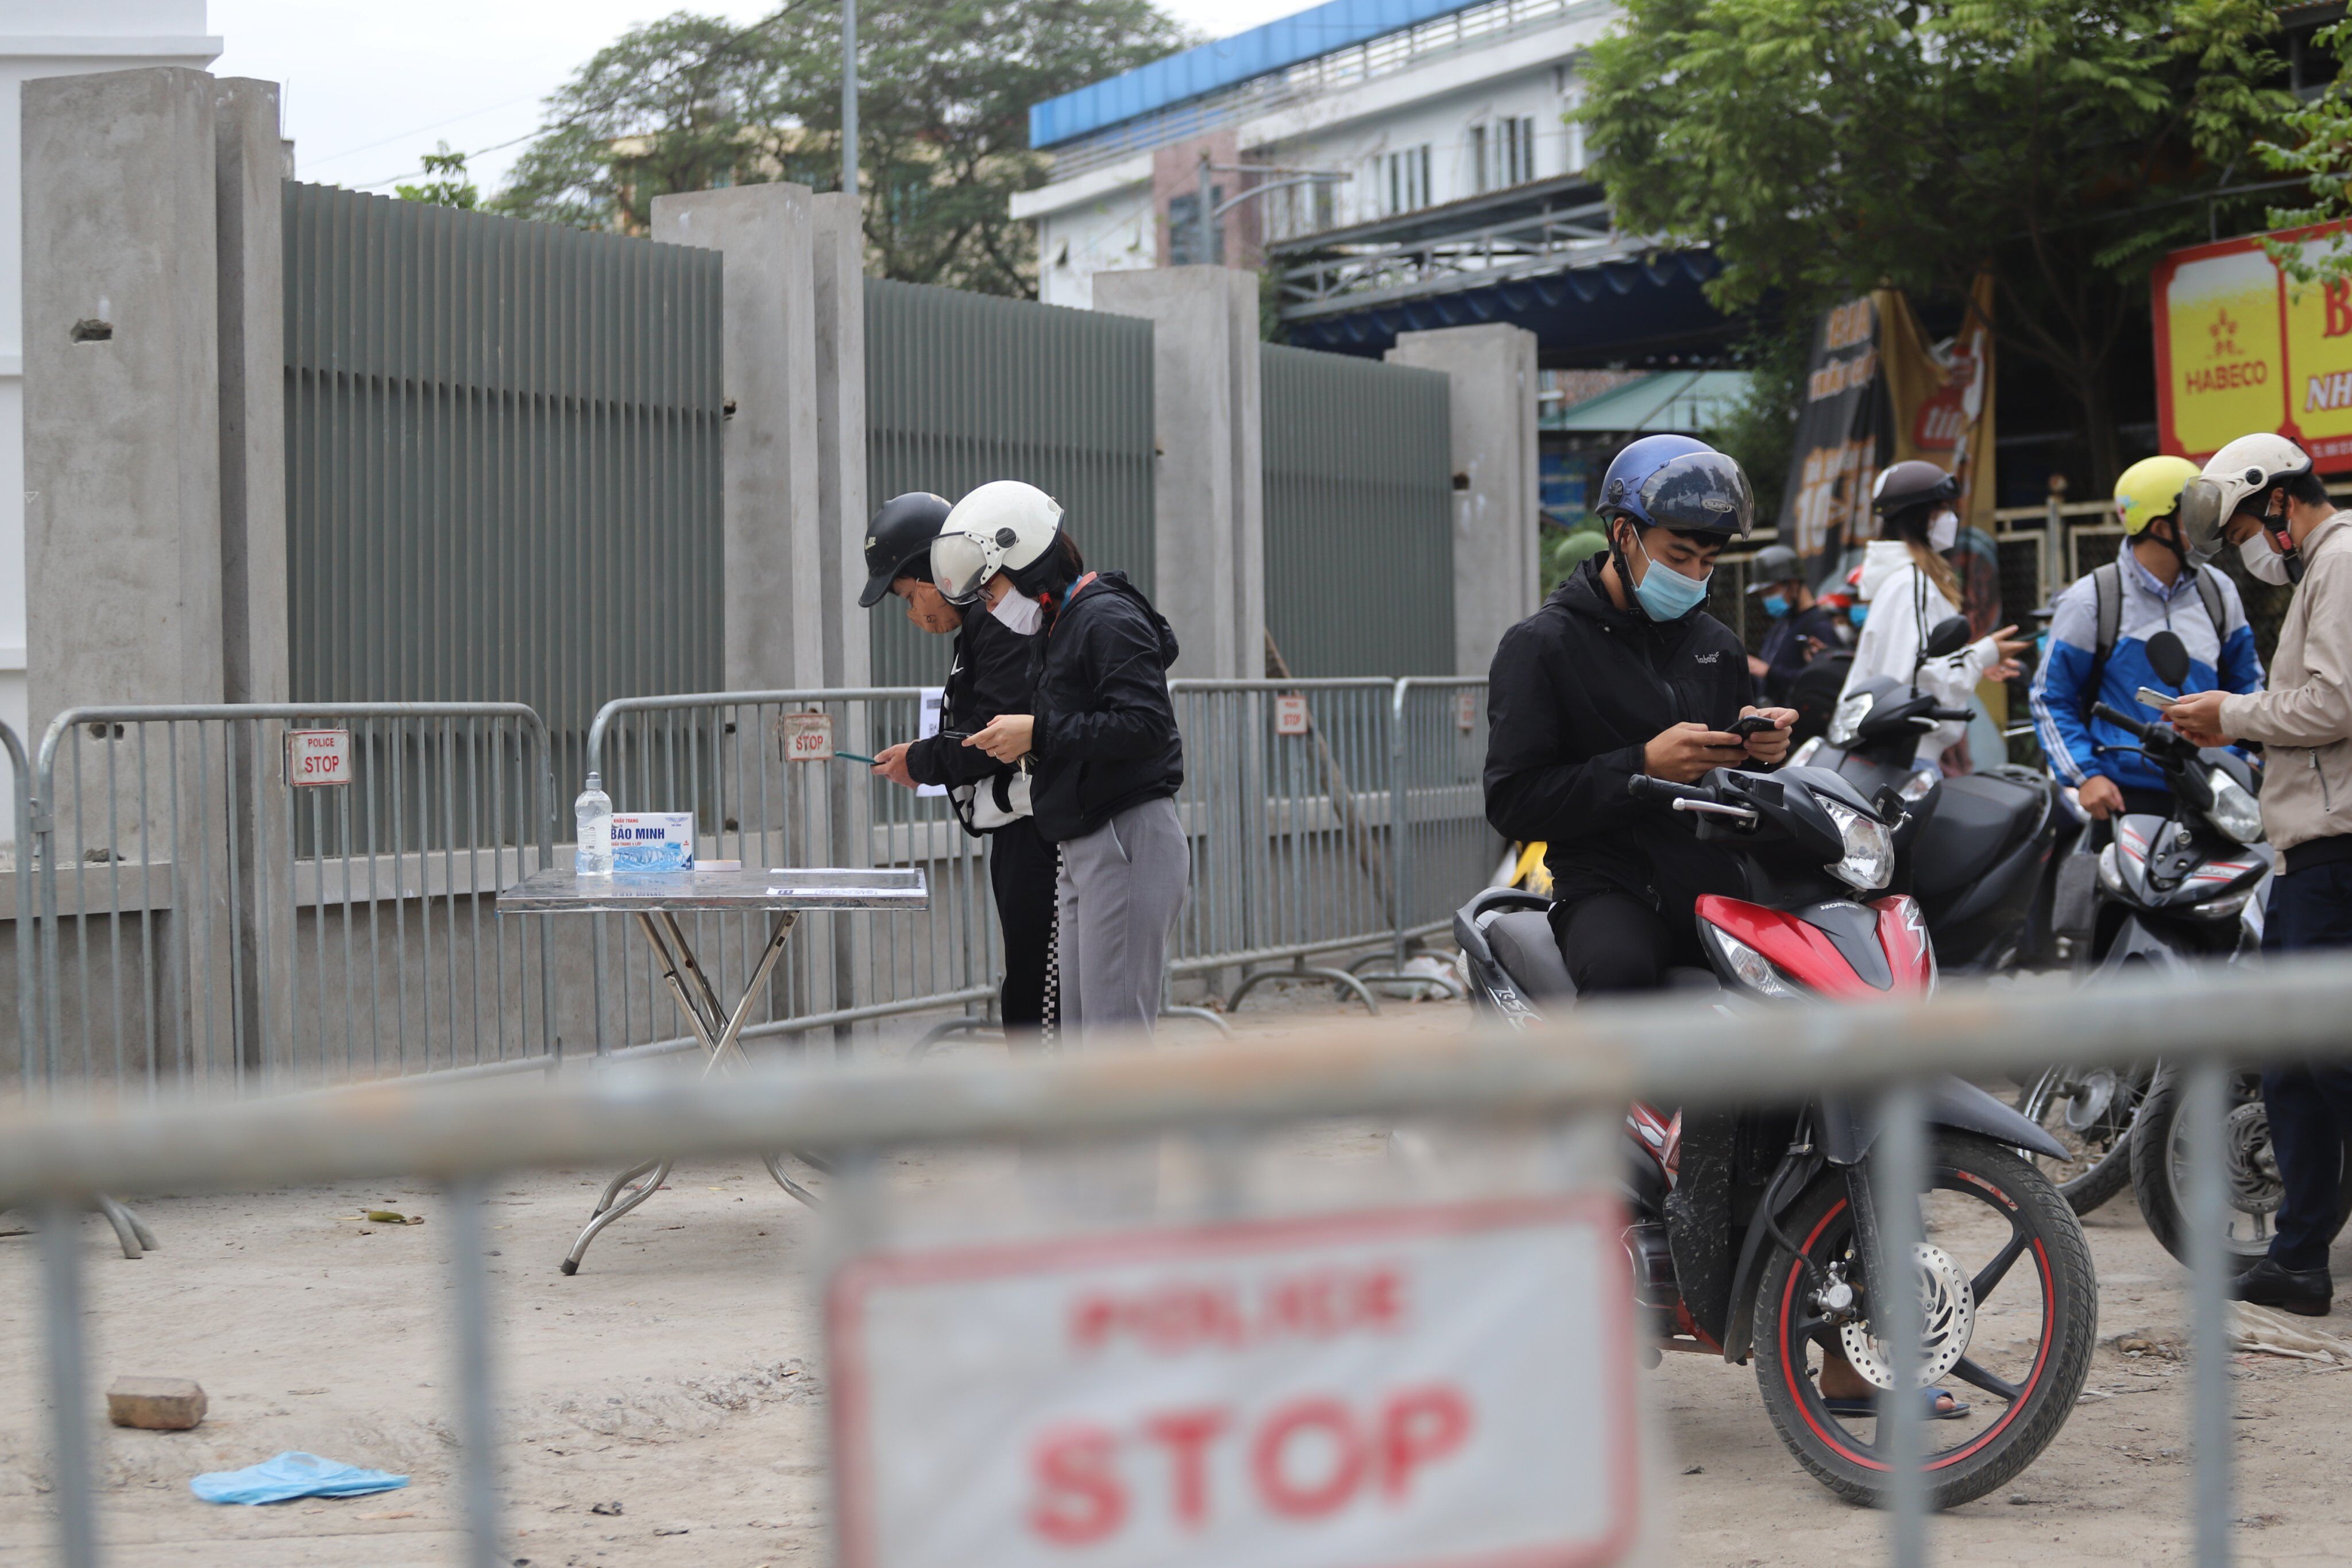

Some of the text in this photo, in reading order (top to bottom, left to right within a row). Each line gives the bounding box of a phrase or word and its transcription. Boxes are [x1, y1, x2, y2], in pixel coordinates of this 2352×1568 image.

[2187, 361, 2268, 394] HABECO
[308, 737, 335, 747] POLICE
[796, 735, 824, 751] STOP
[305, 755, 339, 773] STOP
[611, 825, 631, 840] BẢO
[636, 828, 665, 840] MINH
[1820, 902, 1859, 910] HONDA
[1026, 1382, 1472, 1546] STOP
